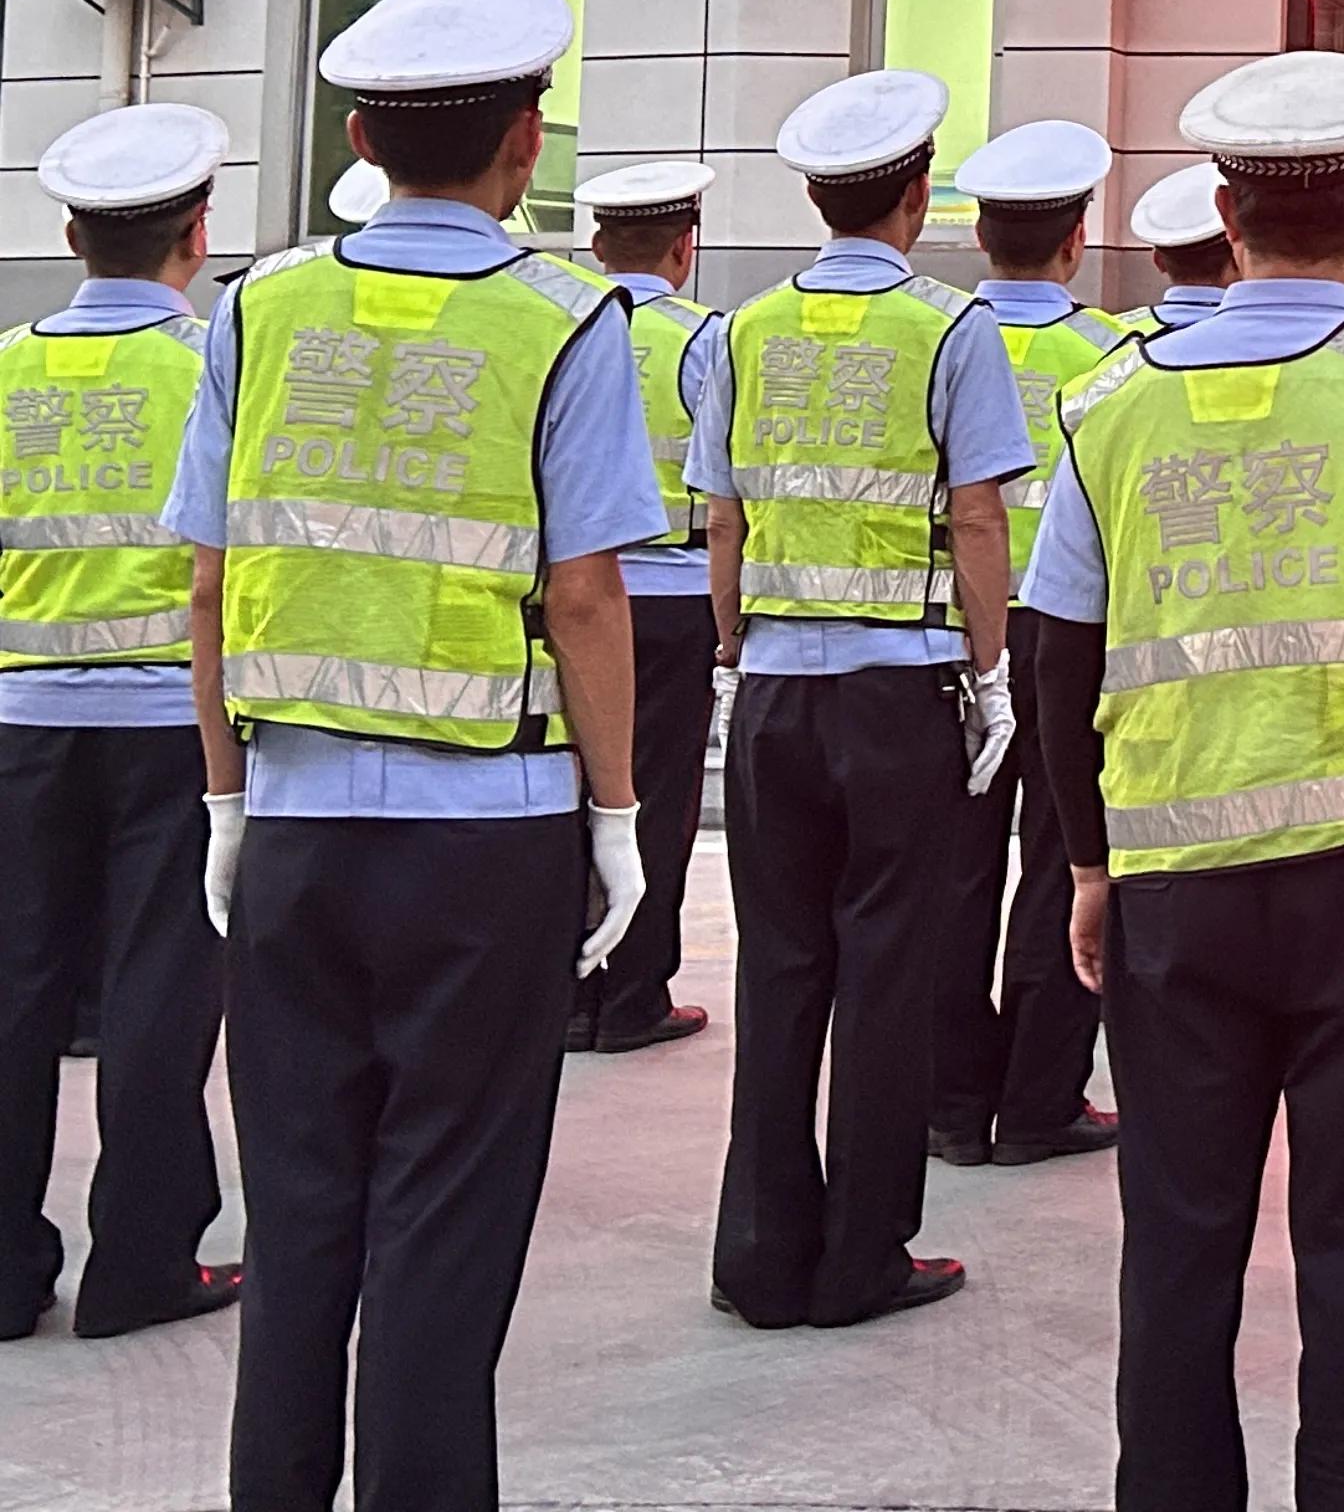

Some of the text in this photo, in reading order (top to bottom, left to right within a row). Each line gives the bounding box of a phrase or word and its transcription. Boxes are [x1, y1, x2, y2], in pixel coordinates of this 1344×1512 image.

[283, 326, 488, 438] 警察
[759, 335, 898, 415] 警察
[4, 383, 151, 460] 警察
[754, 415, 888, 450] POLICE
[2, 461, 153, 496] POLICE
[261, 436, 469, 494] POLICE
[1140, 439, 1334, 553] 警察
[1148, 545, 1340, 607] POLICE
